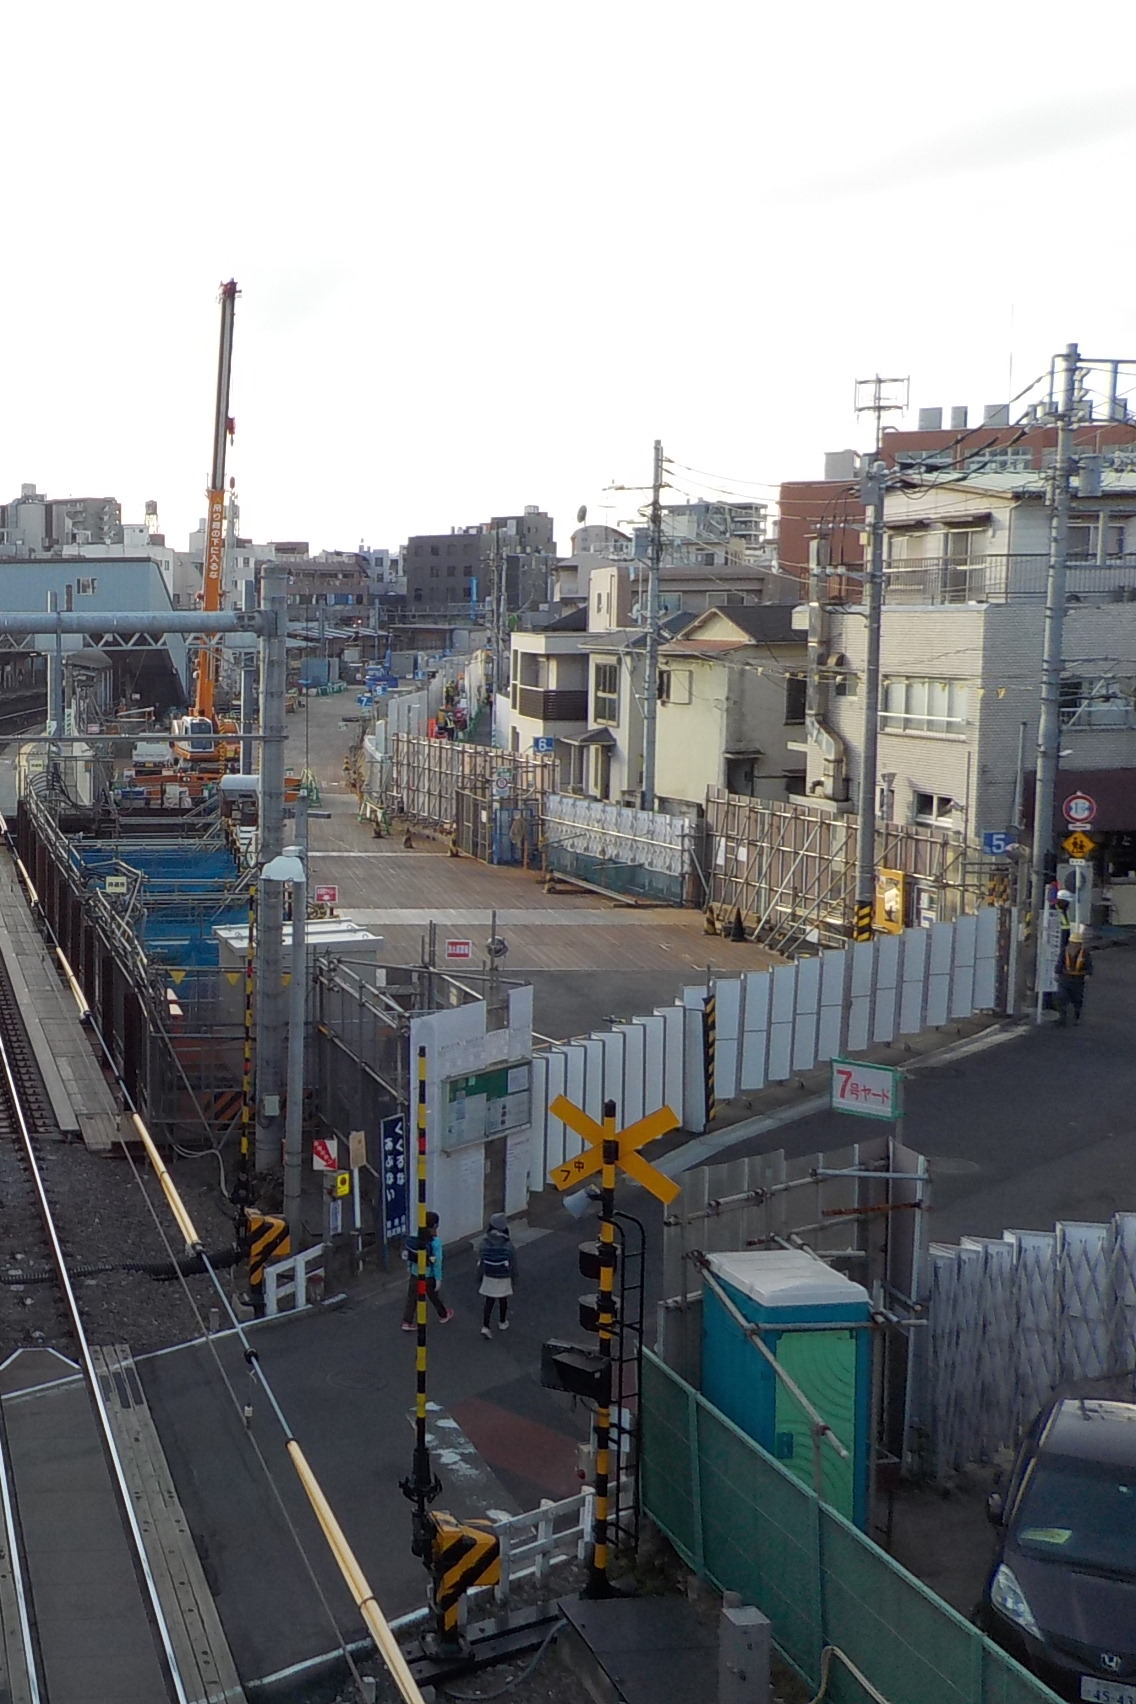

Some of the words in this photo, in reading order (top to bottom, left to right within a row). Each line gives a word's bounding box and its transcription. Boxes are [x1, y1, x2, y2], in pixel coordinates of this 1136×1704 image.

[538, 738, 547, 751] 6
[992, 834, 1006, 853] 5
[836, 1069, 890, 1105] 7号ヤード
[394, 1121, 405, 1186] くぐるな
